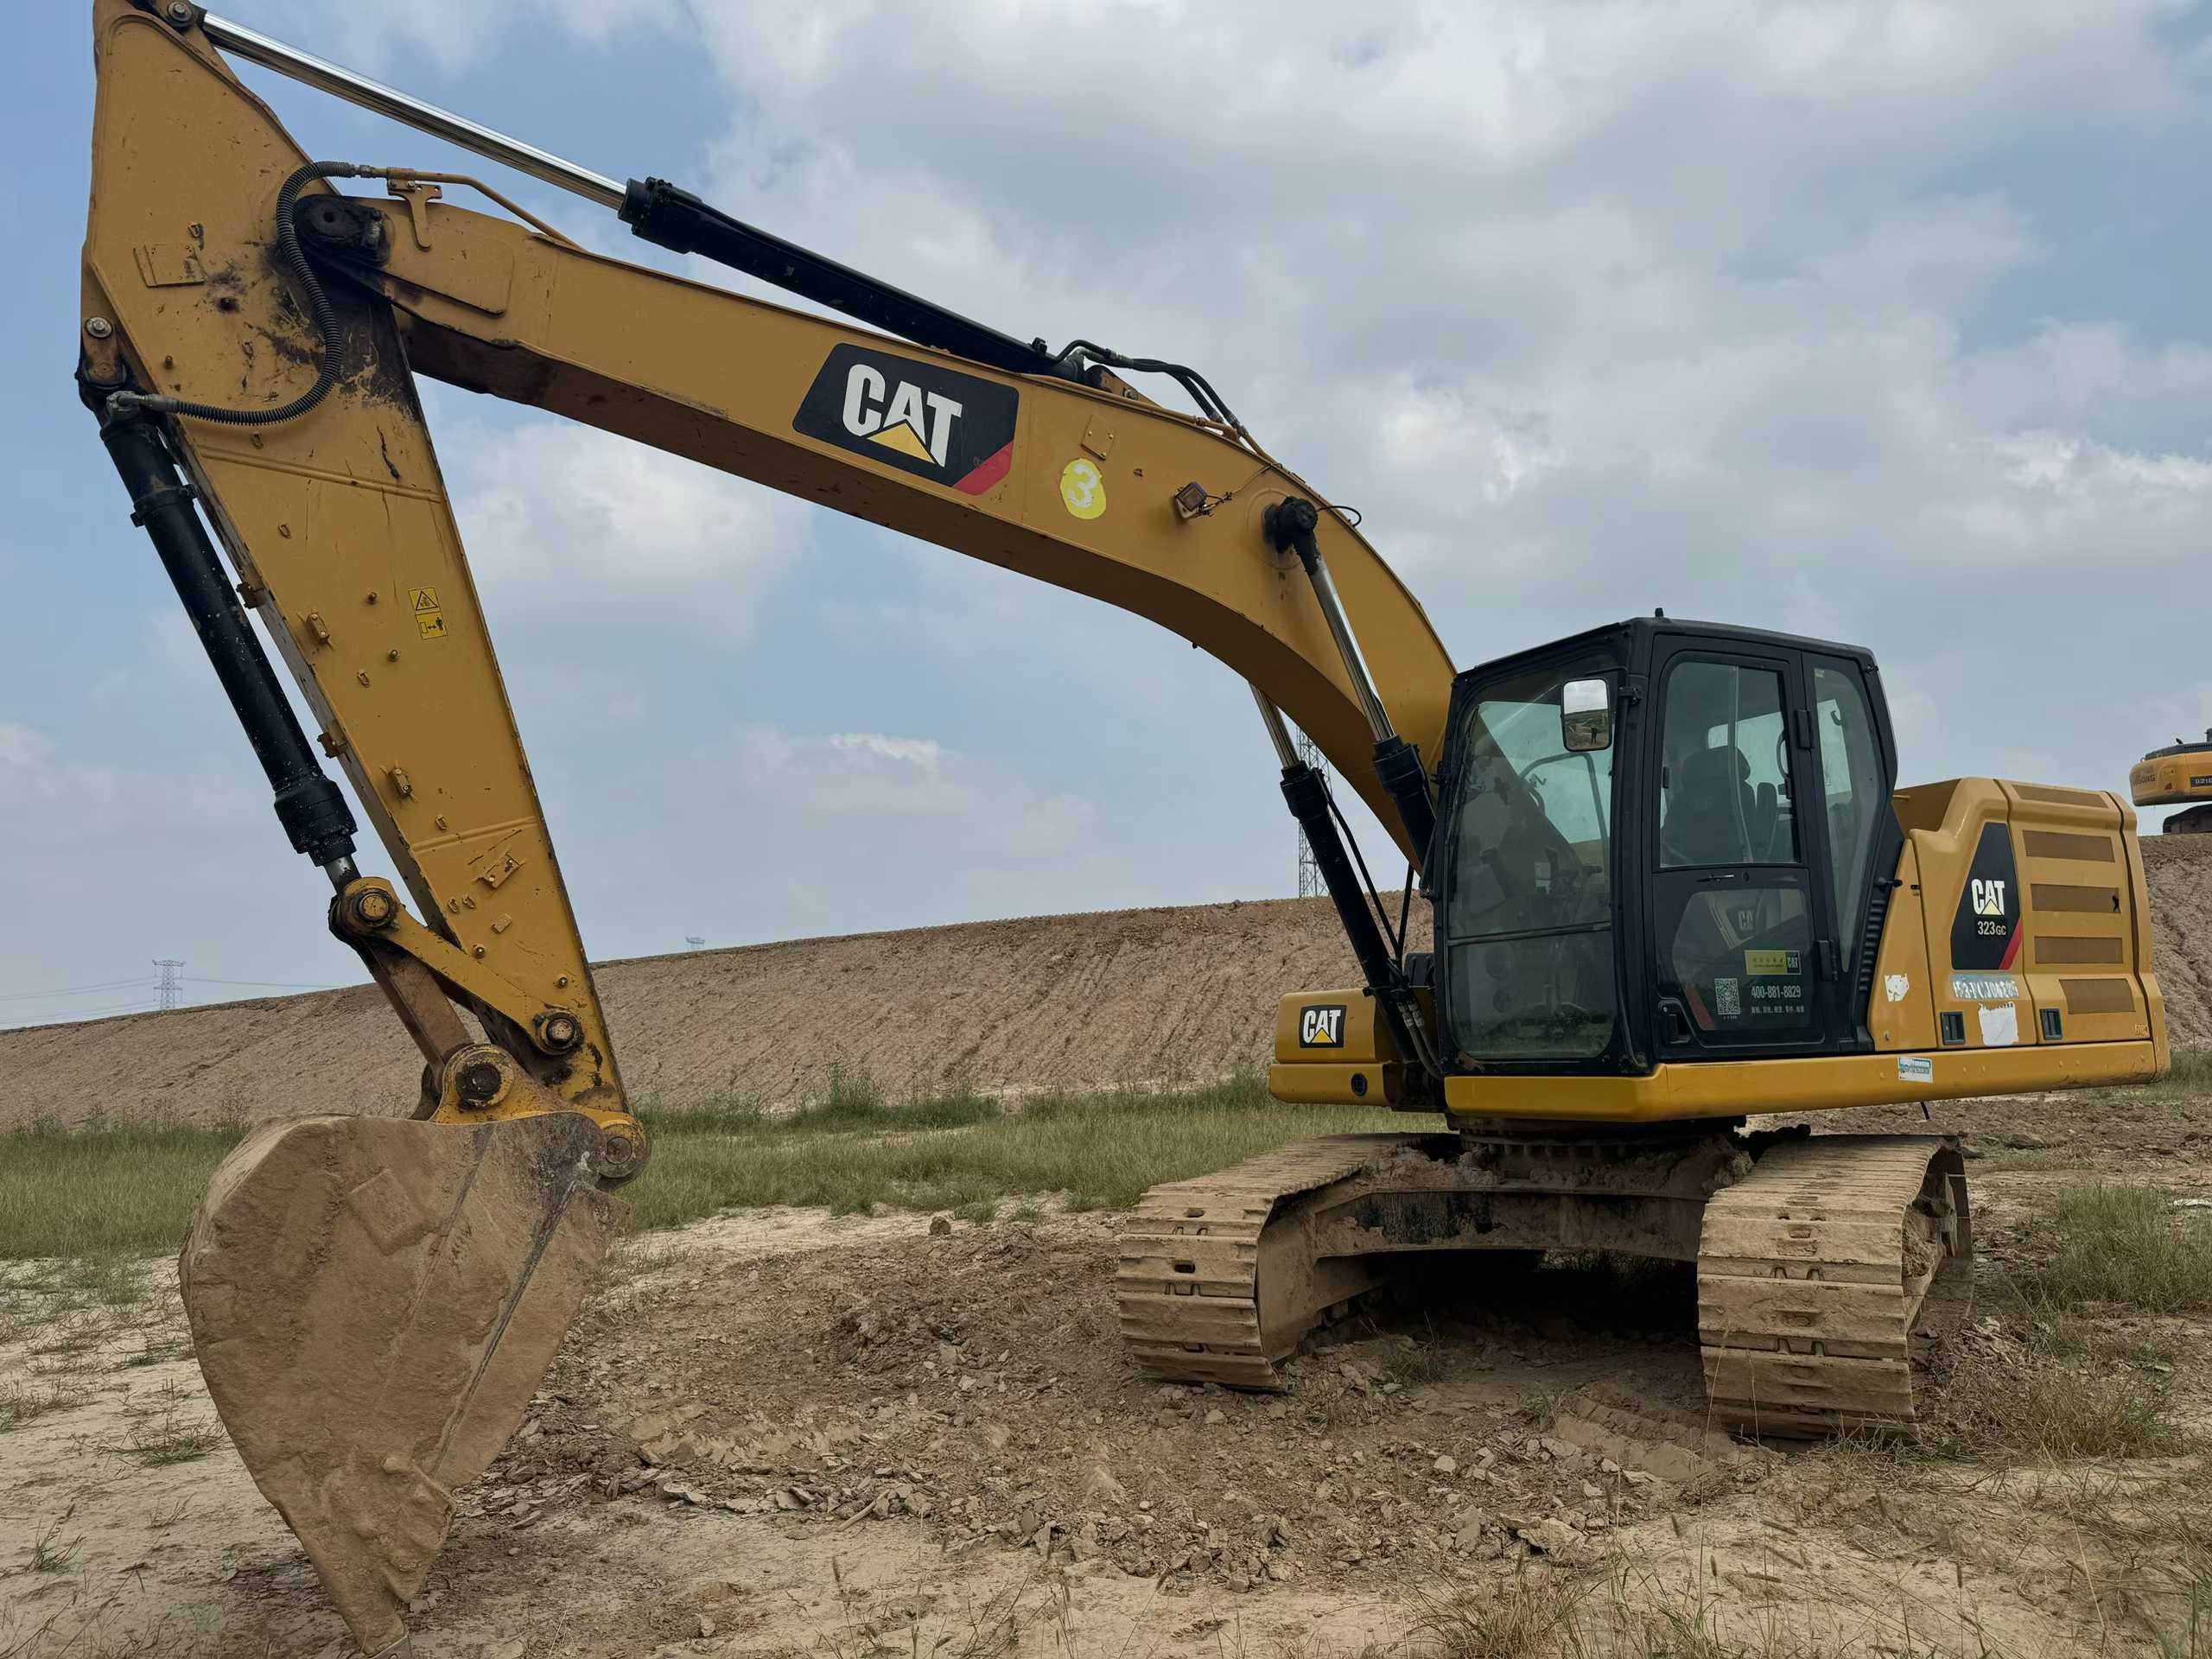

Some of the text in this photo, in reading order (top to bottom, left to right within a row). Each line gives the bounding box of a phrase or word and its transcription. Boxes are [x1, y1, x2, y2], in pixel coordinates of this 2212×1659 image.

[842, 363, 963, 467] CAT
[1067, 463, 1097, 509] 3
[1971, 878, 2005, 916] CAT
[1751, 985, 1802, 999] 400-881-8829
[1303, 1009, 1342, 1044] CAT
